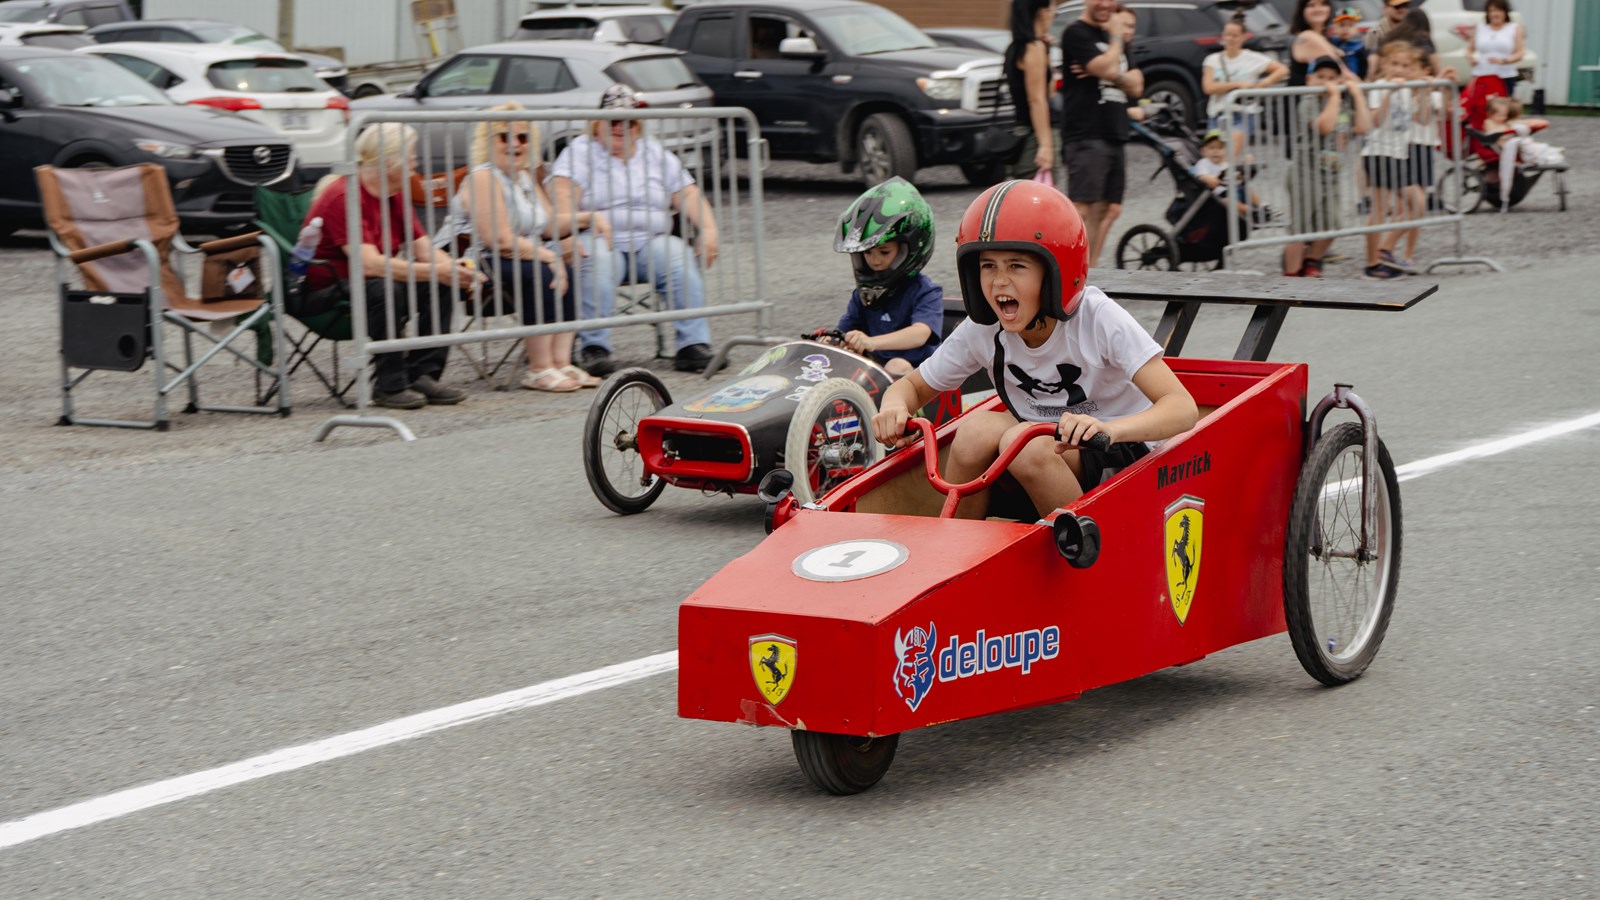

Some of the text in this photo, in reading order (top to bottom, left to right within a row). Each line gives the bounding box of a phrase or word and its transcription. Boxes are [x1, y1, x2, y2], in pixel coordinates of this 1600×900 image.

[1157, 451, 1211, 489] Mavrick
[827, 550, 867, 568] 1
[938, 625, 1060, 682] deloupe
